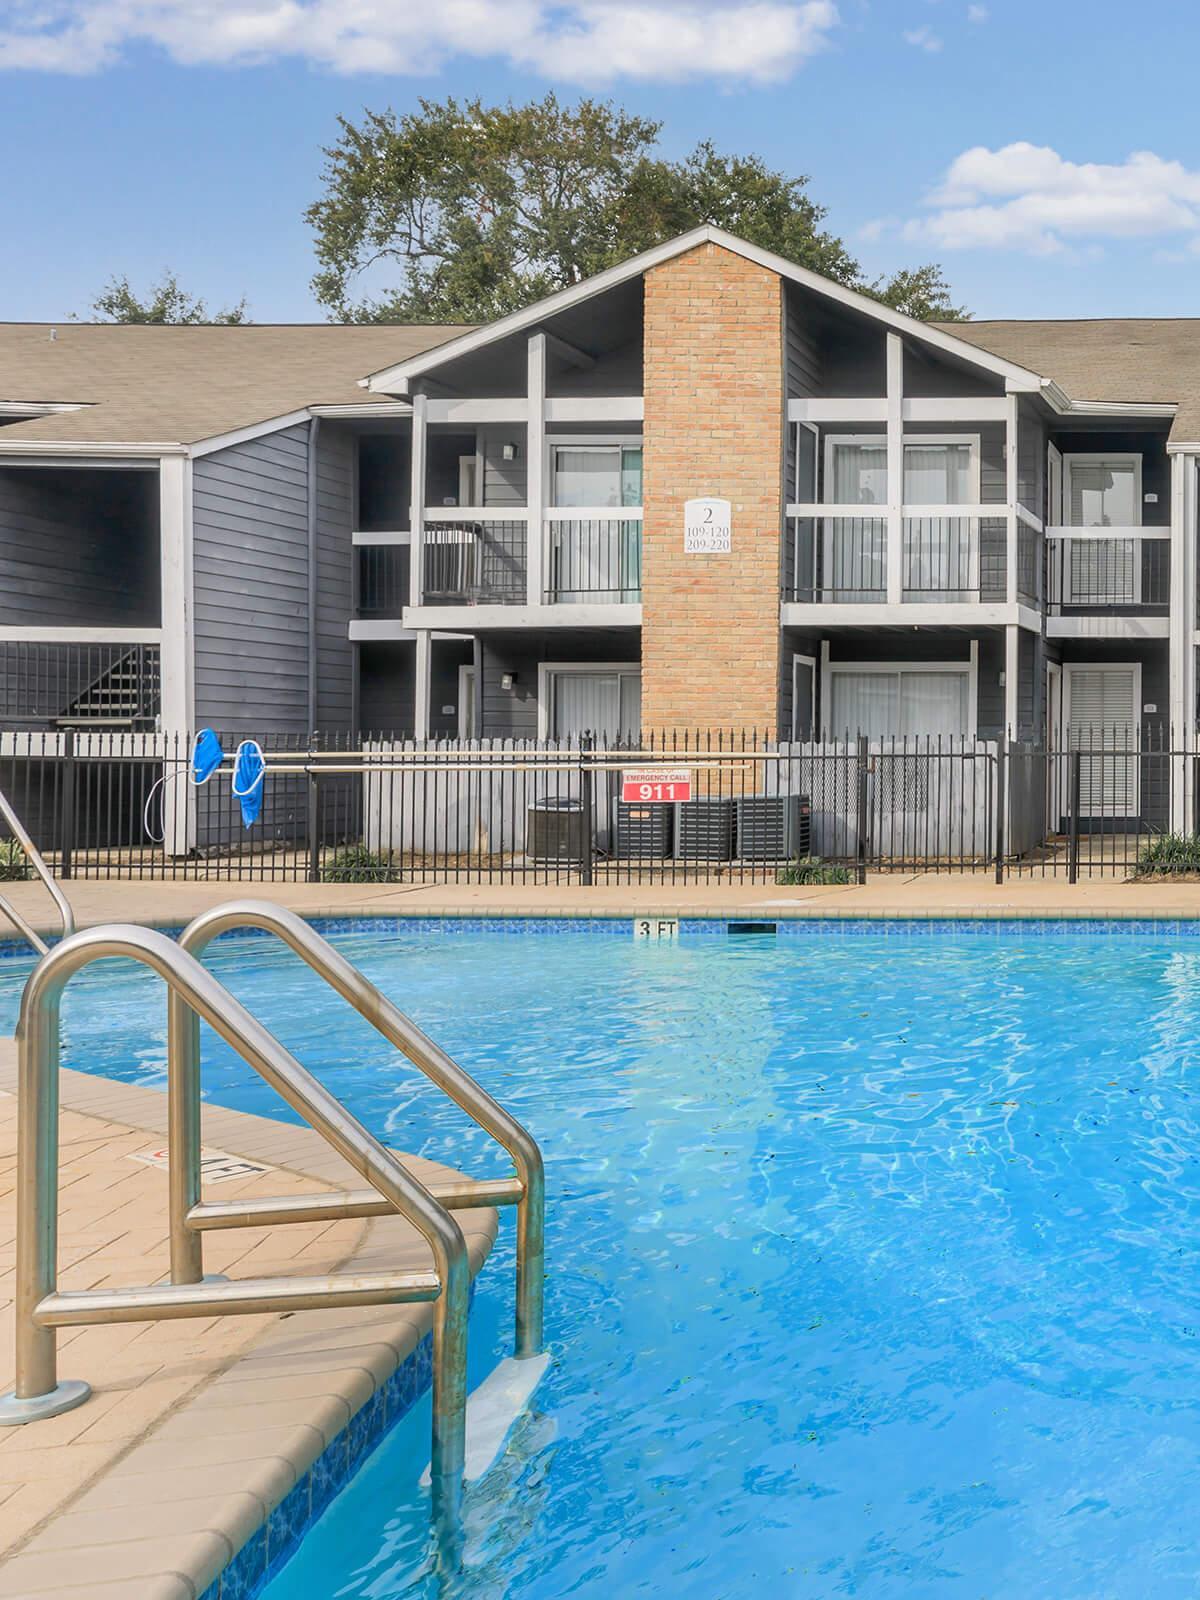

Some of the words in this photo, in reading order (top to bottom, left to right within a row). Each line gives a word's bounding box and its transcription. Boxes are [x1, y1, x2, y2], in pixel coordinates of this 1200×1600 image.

[703, 507, 713, 524] 2
[688, 527, 730, 537] 109-120
[687, 539, 730, 550] 209-220
[639, 783, 675, 800] 911
[640, 921, 650, 935] 3
[657, 921, 676, 934] FT
